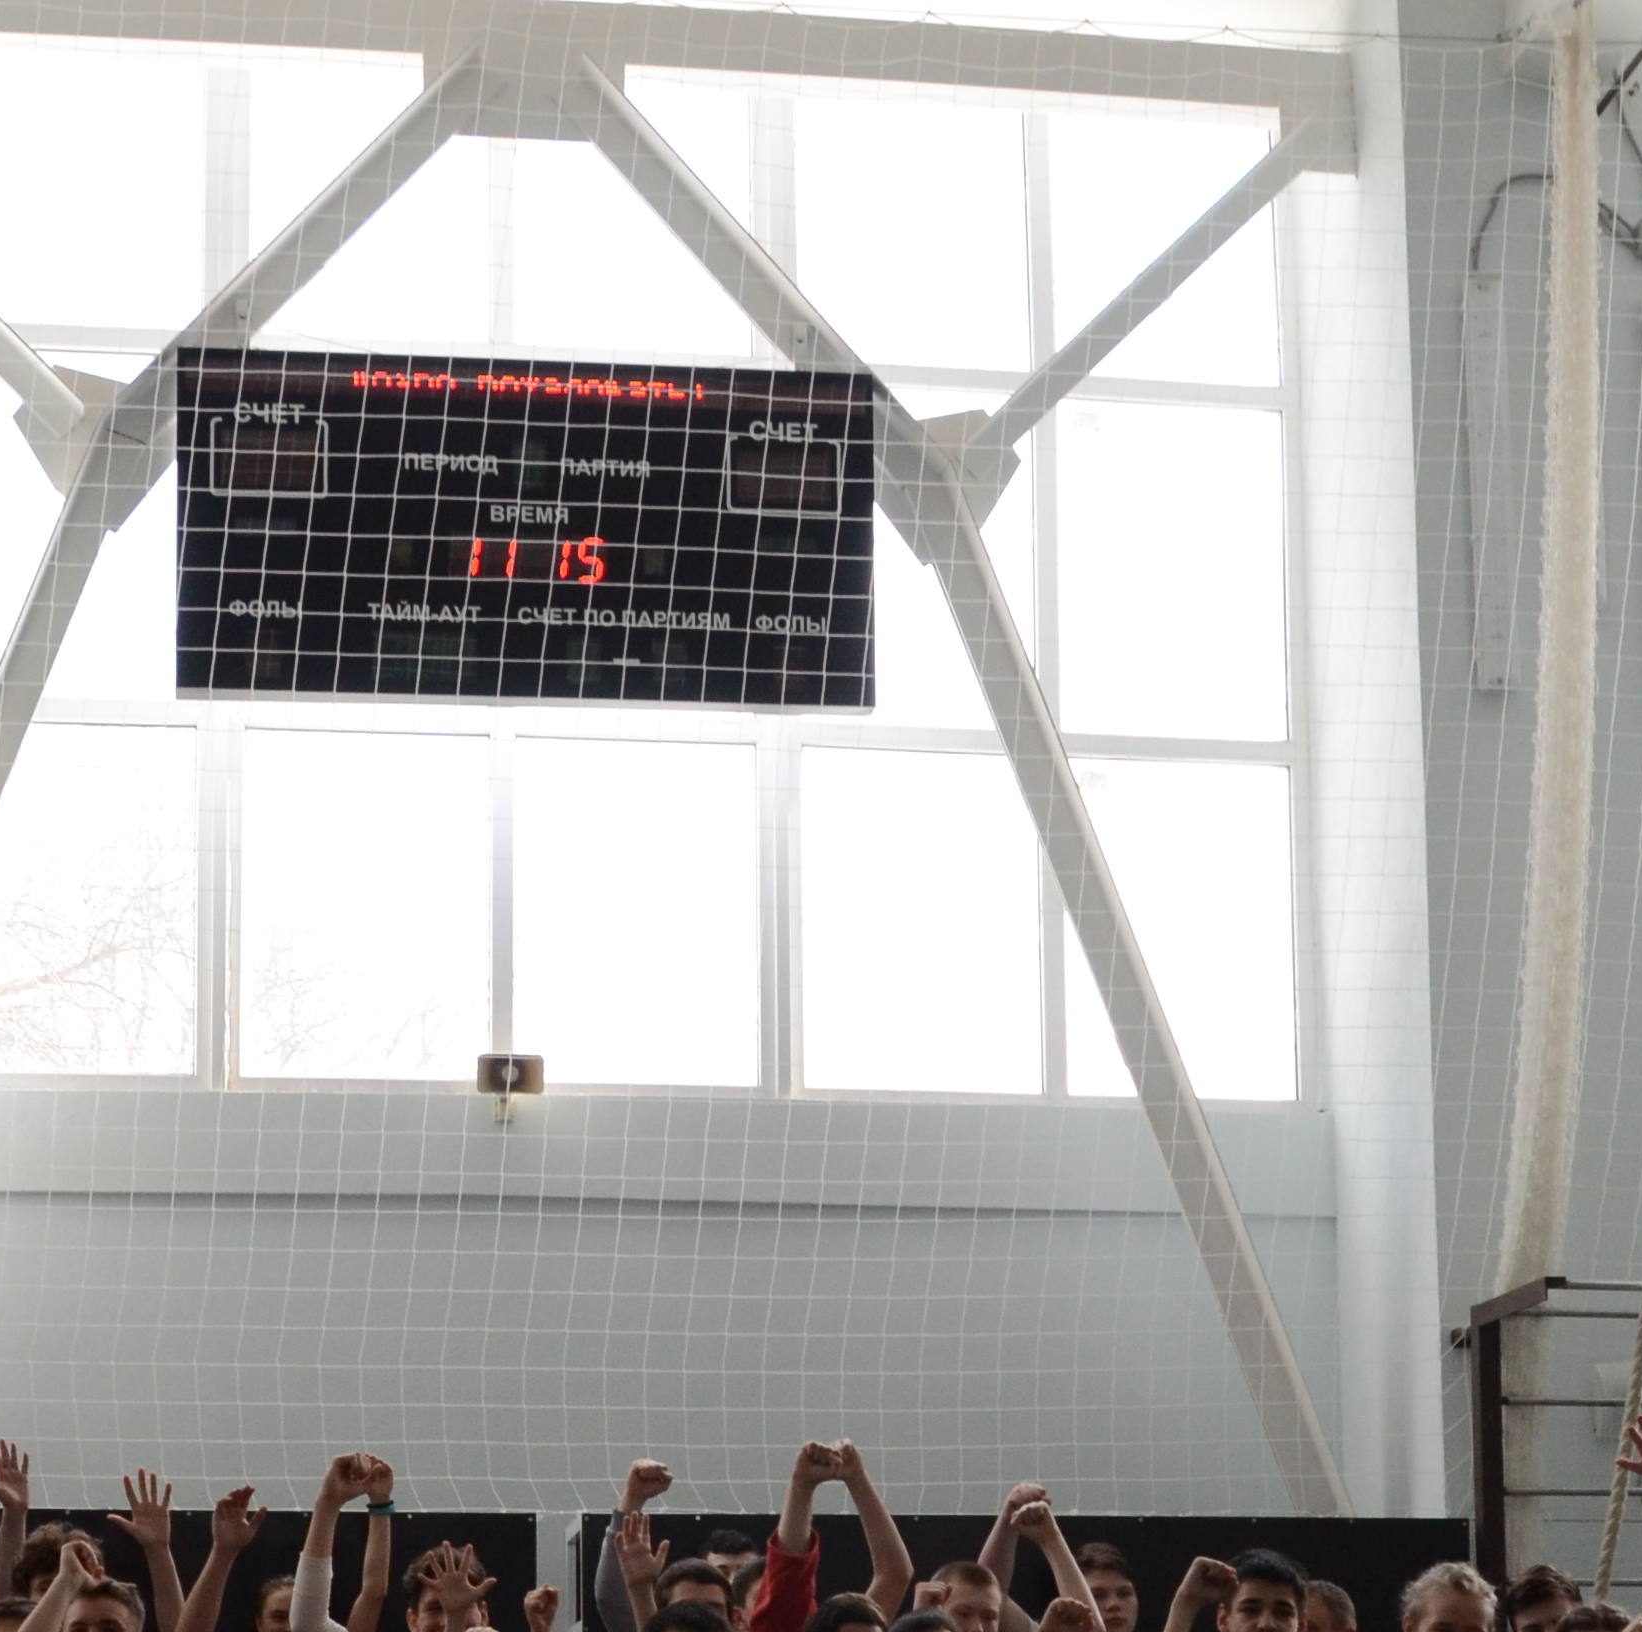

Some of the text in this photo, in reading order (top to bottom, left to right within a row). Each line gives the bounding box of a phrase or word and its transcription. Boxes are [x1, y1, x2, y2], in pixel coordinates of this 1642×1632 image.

[234, 403, 305, 424] СЧЕТ
[748, 420, 818, 443] СЧЕТ
[404, 452, 499, 476] ПЕРИОД
[560, 457, 650, 478] ПАРТИЯ
[490, 504, 569, 524] ВРЕМЯ
[228, 599, 303, 619] ФОЛЫ
[366, 599, 482, 623] ТАЙМ-АУТ
[517, 607, 731, 630] СЧЕТ ПО ПАРТИЯМ
[754, 614, 828, 634] ФОЛЫ
